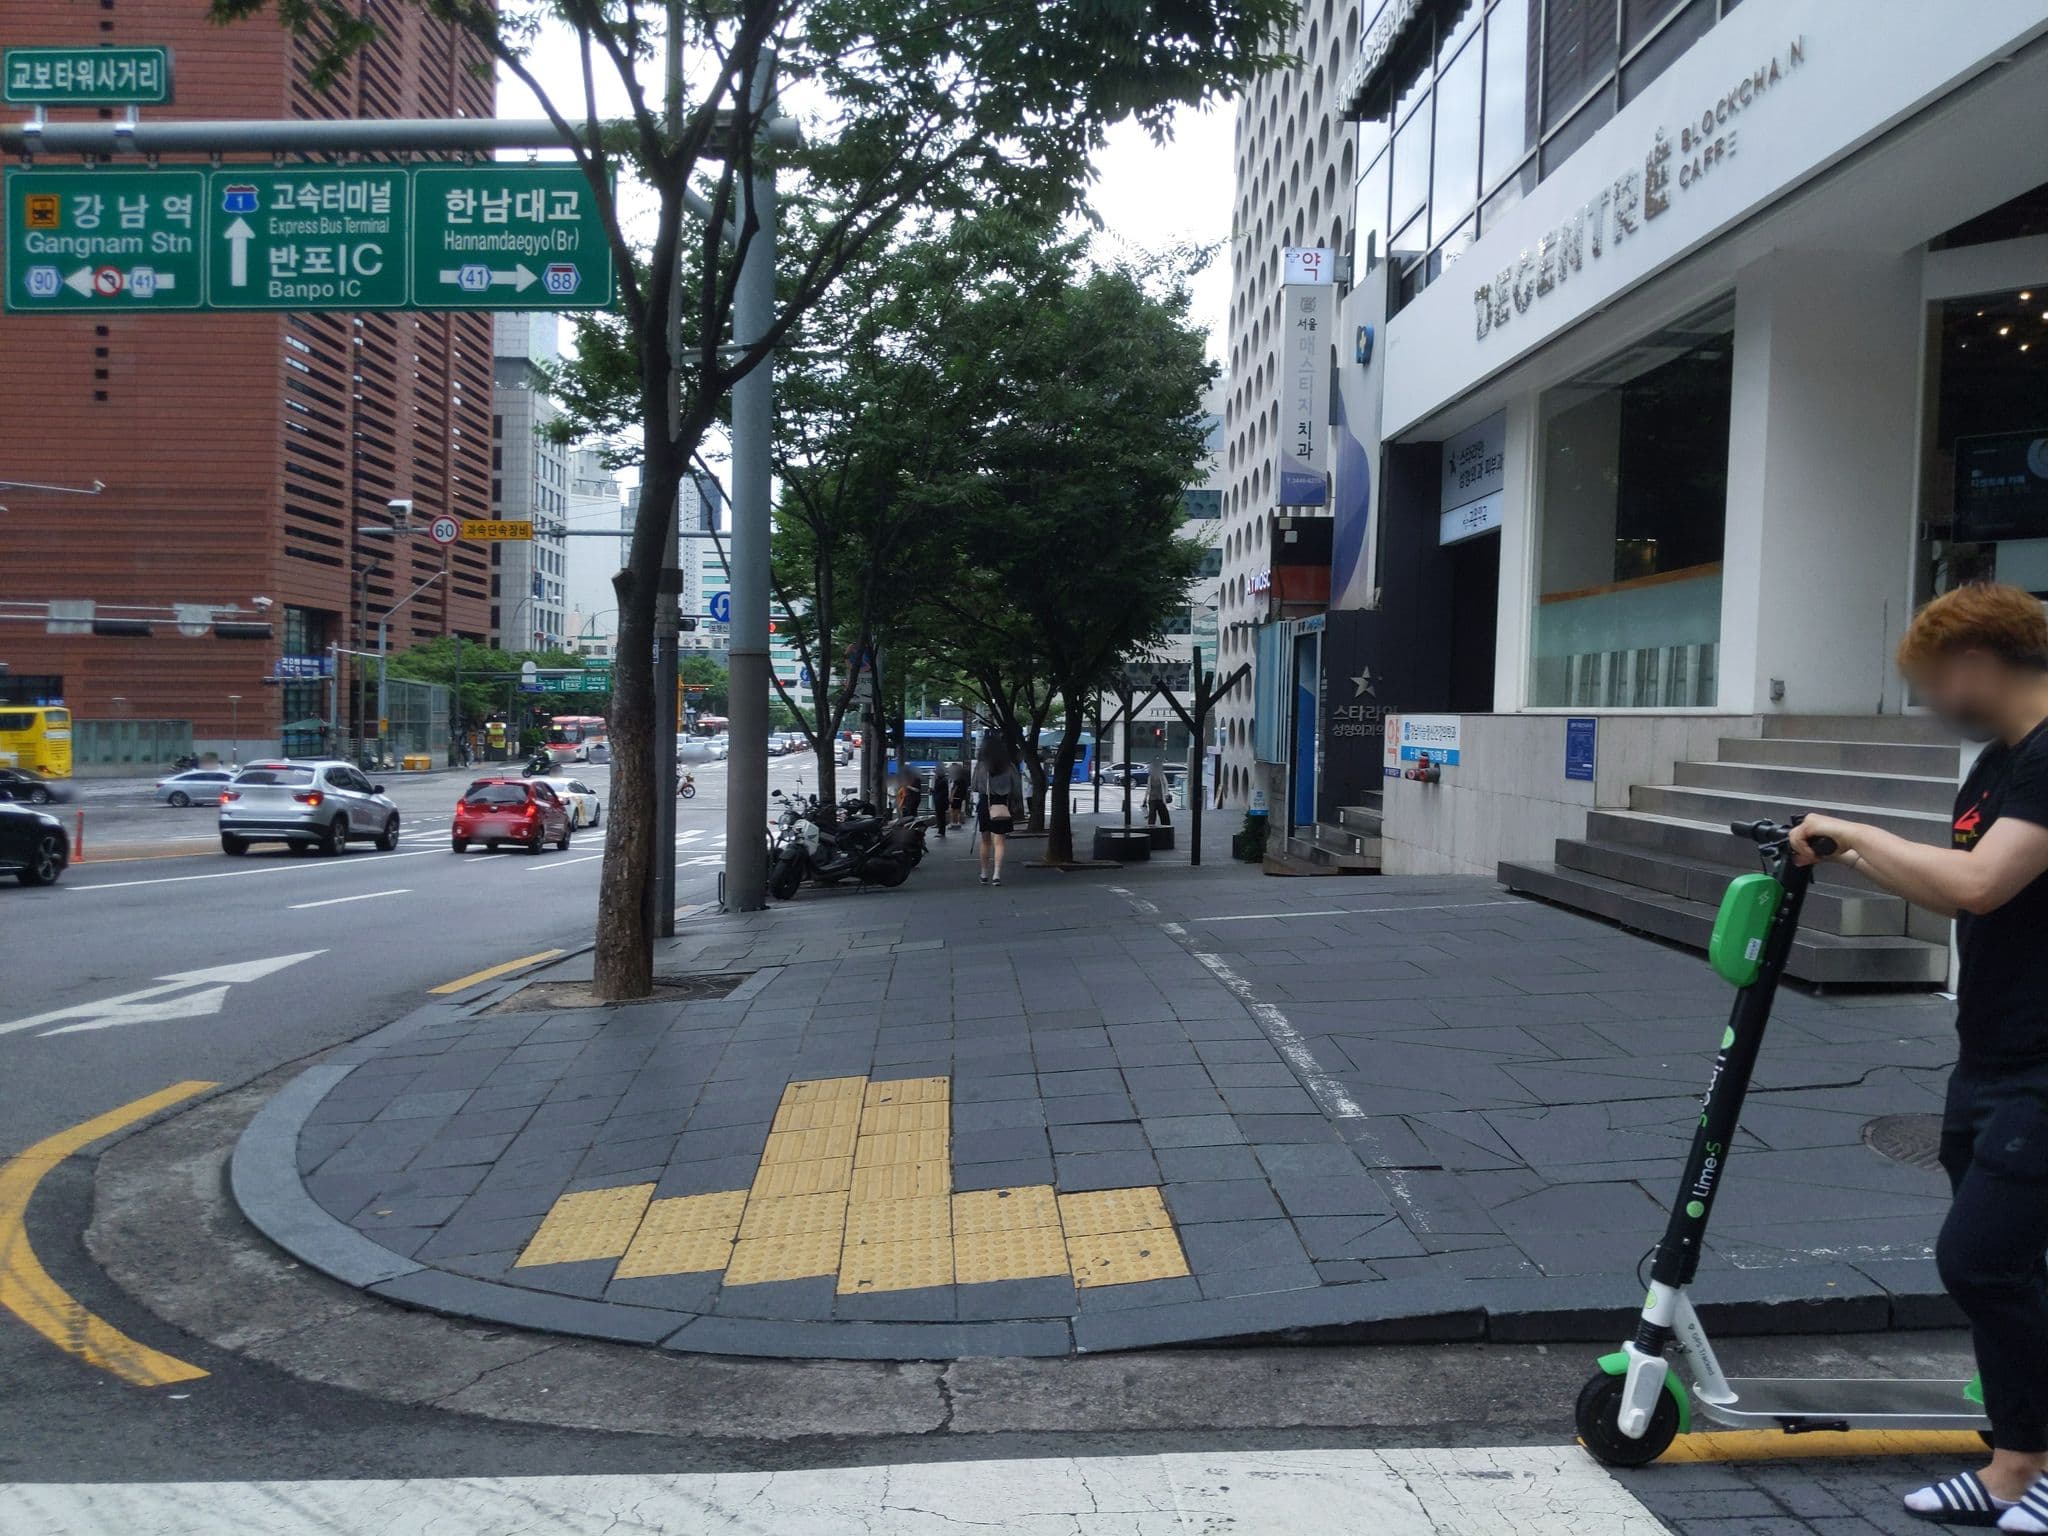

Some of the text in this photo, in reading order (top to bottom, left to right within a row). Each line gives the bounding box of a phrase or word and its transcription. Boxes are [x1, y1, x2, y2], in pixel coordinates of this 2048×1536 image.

[11, 59, 158, 91] 교보타워사거리
[271, 180, 391, 214] 고속터미널
[445, 188, 582, 224] 한남대교
[269, 216, 390, 237] Express Bus Terminal
[25, 231, 192, 259] Gangnam Stn
[444, 227, 580, 256] Hannamdaegyo(Br)
[270, 243, 384, 278] 반포IC
[34, 271, 53, 291] 90
[135, 274, 150, 288] 41
[465, 269, 484, 286] 41
[551, 273, 572, 290] 88
[269, 279, 361, 301] Banpo IC
[1296, 317, 1318, 331] 서울
[435, 524, 454, 538] 60
[466, 524, 529, 537] 과속단속장비
